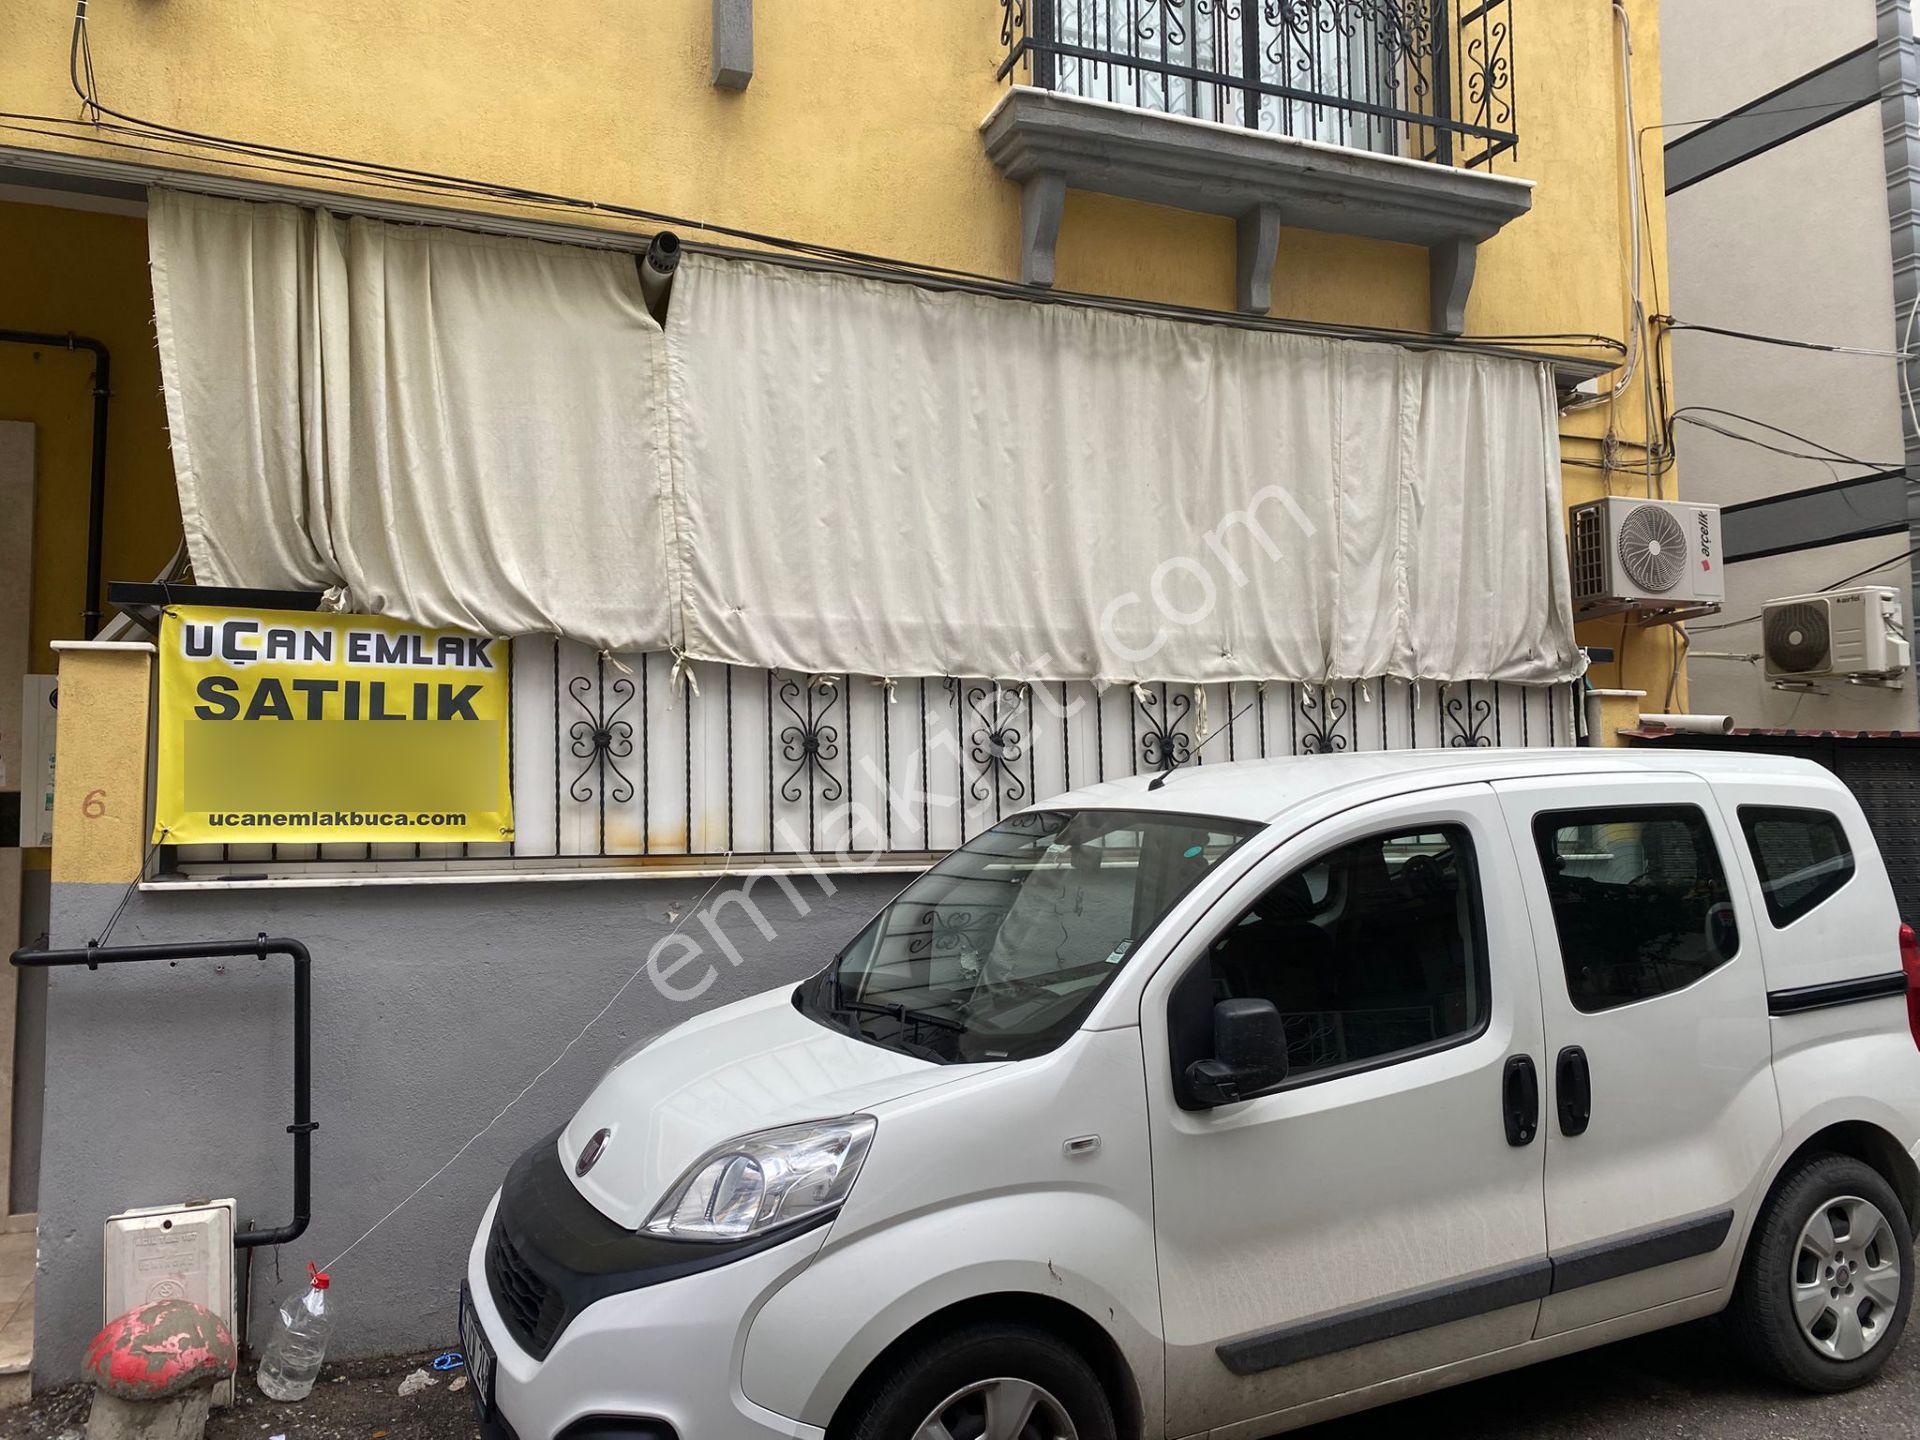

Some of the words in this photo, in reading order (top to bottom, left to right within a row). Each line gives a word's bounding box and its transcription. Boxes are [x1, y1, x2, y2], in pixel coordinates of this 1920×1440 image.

[1698, 511, 1711, 557] arçelik
[348, 632, 493, 668] EMLAK
[194, 675, 484, 721] SATILIK
[82, 789, 106, 819] 6
[209, 811, 466, 826] ucanemlakbuca.com
